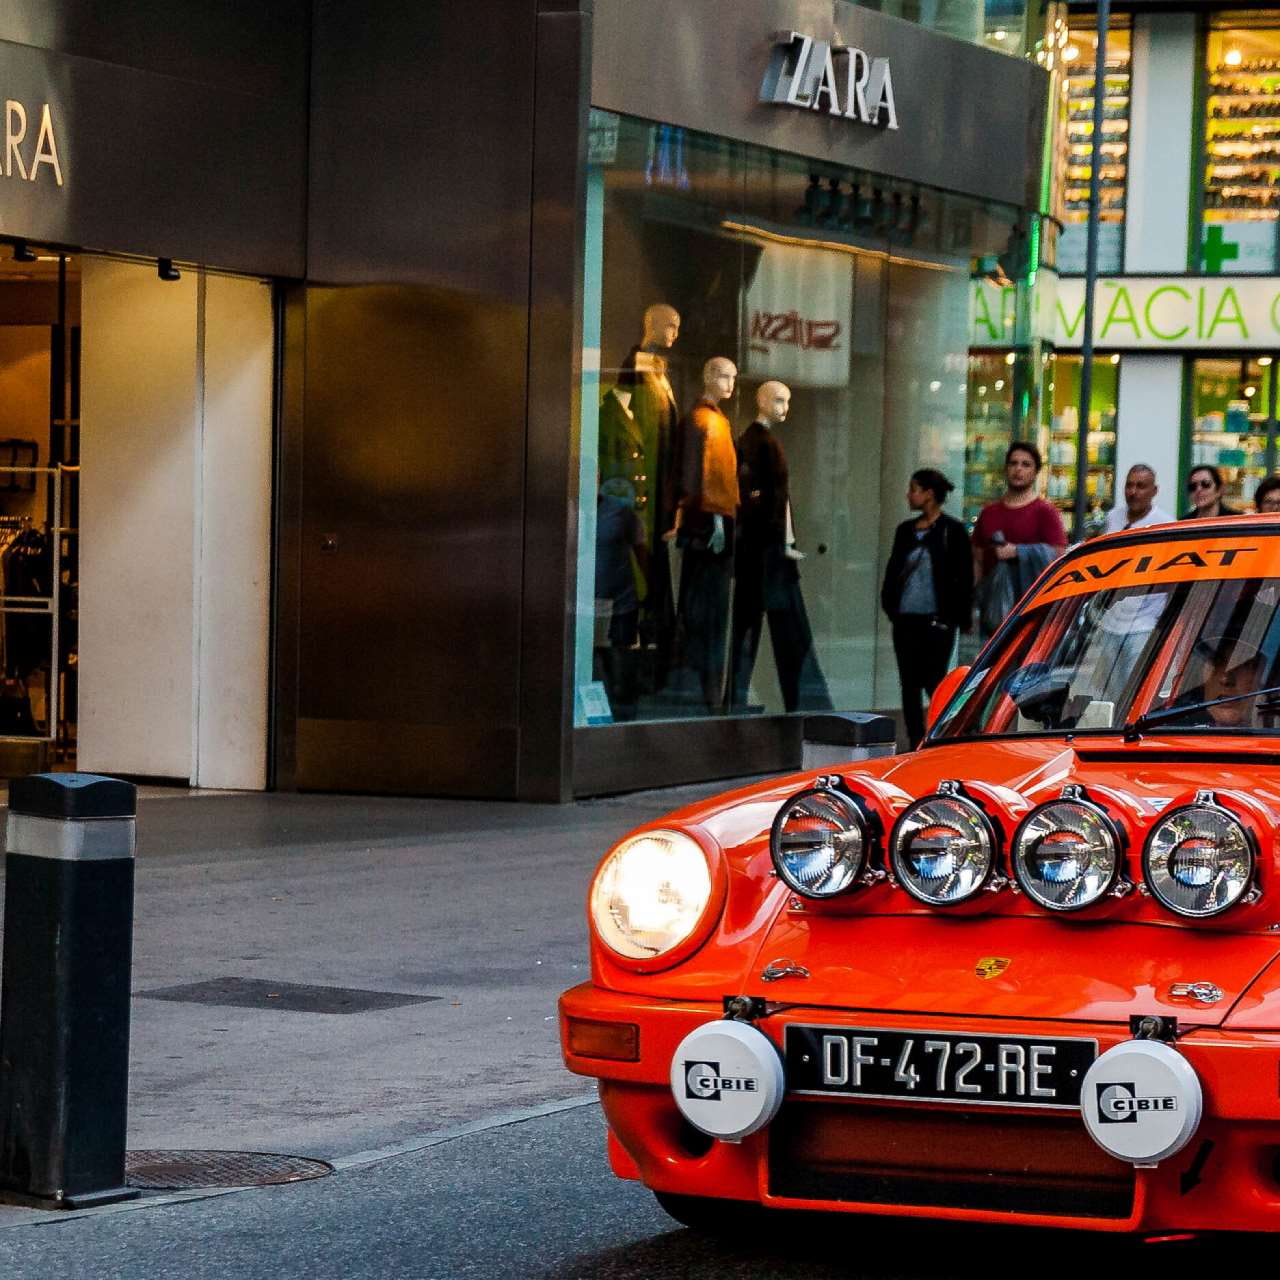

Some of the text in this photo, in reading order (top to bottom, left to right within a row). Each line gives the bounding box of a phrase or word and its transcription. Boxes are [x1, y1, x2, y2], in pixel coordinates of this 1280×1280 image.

[787, 31, 900, 129] ZARA
[1042, 547, 1258, 595] AVIAT
[823, 1034, 1057, 1098] DF-472-RE
